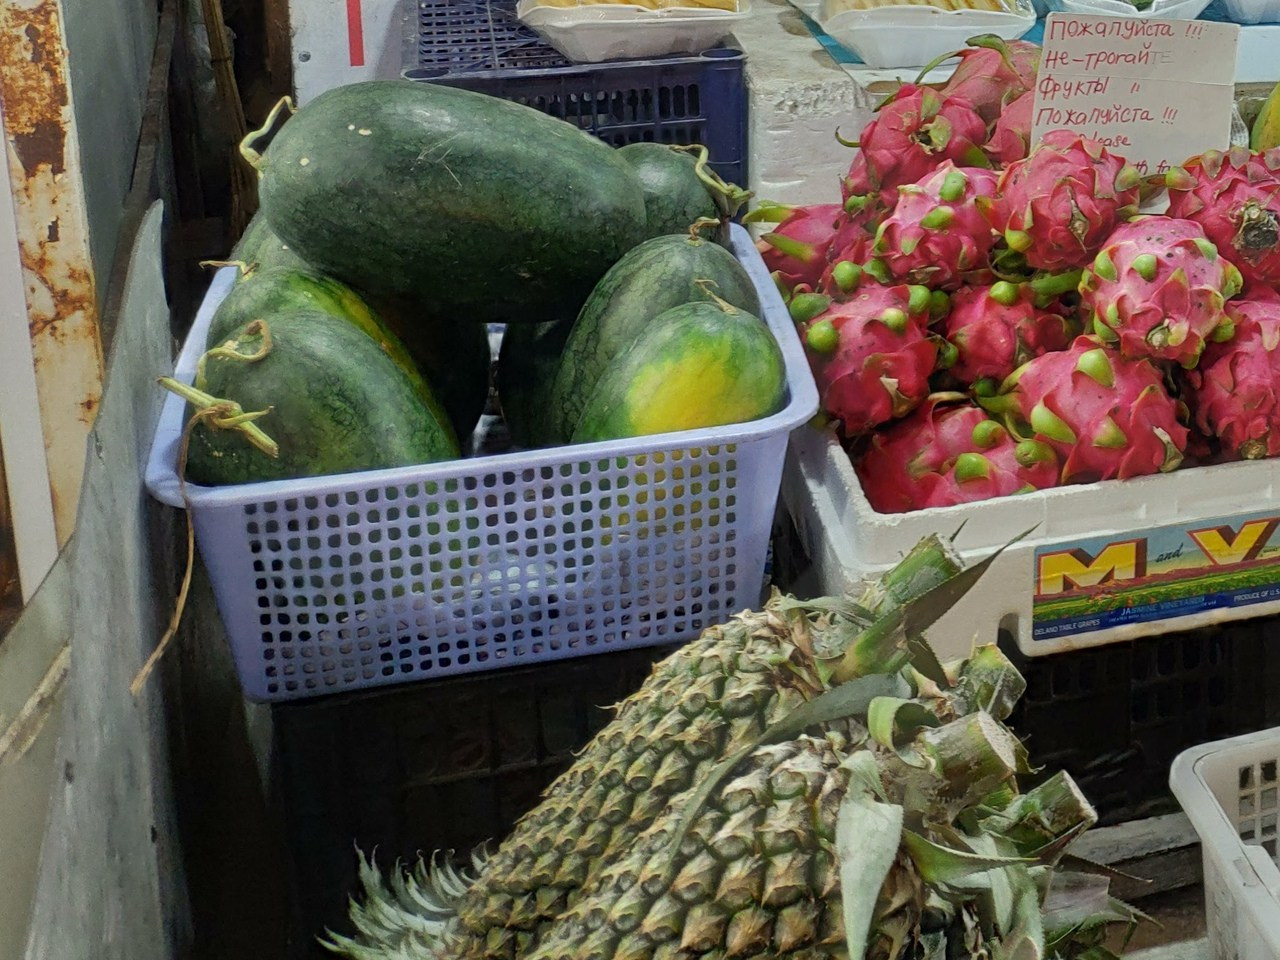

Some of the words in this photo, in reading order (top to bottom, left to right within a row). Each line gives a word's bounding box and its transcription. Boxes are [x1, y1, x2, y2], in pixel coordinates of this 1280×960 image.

[1080, 131, 1131, 148] lease
[1037, 538, 1148, 595] M
[1155, 542, 1184, 563] and
[1234, 592, 1260, 602] PRODUCE
[1059, 622, 1077, 631] TABLE
[1078, 619, 1100, 628] GRAPES
